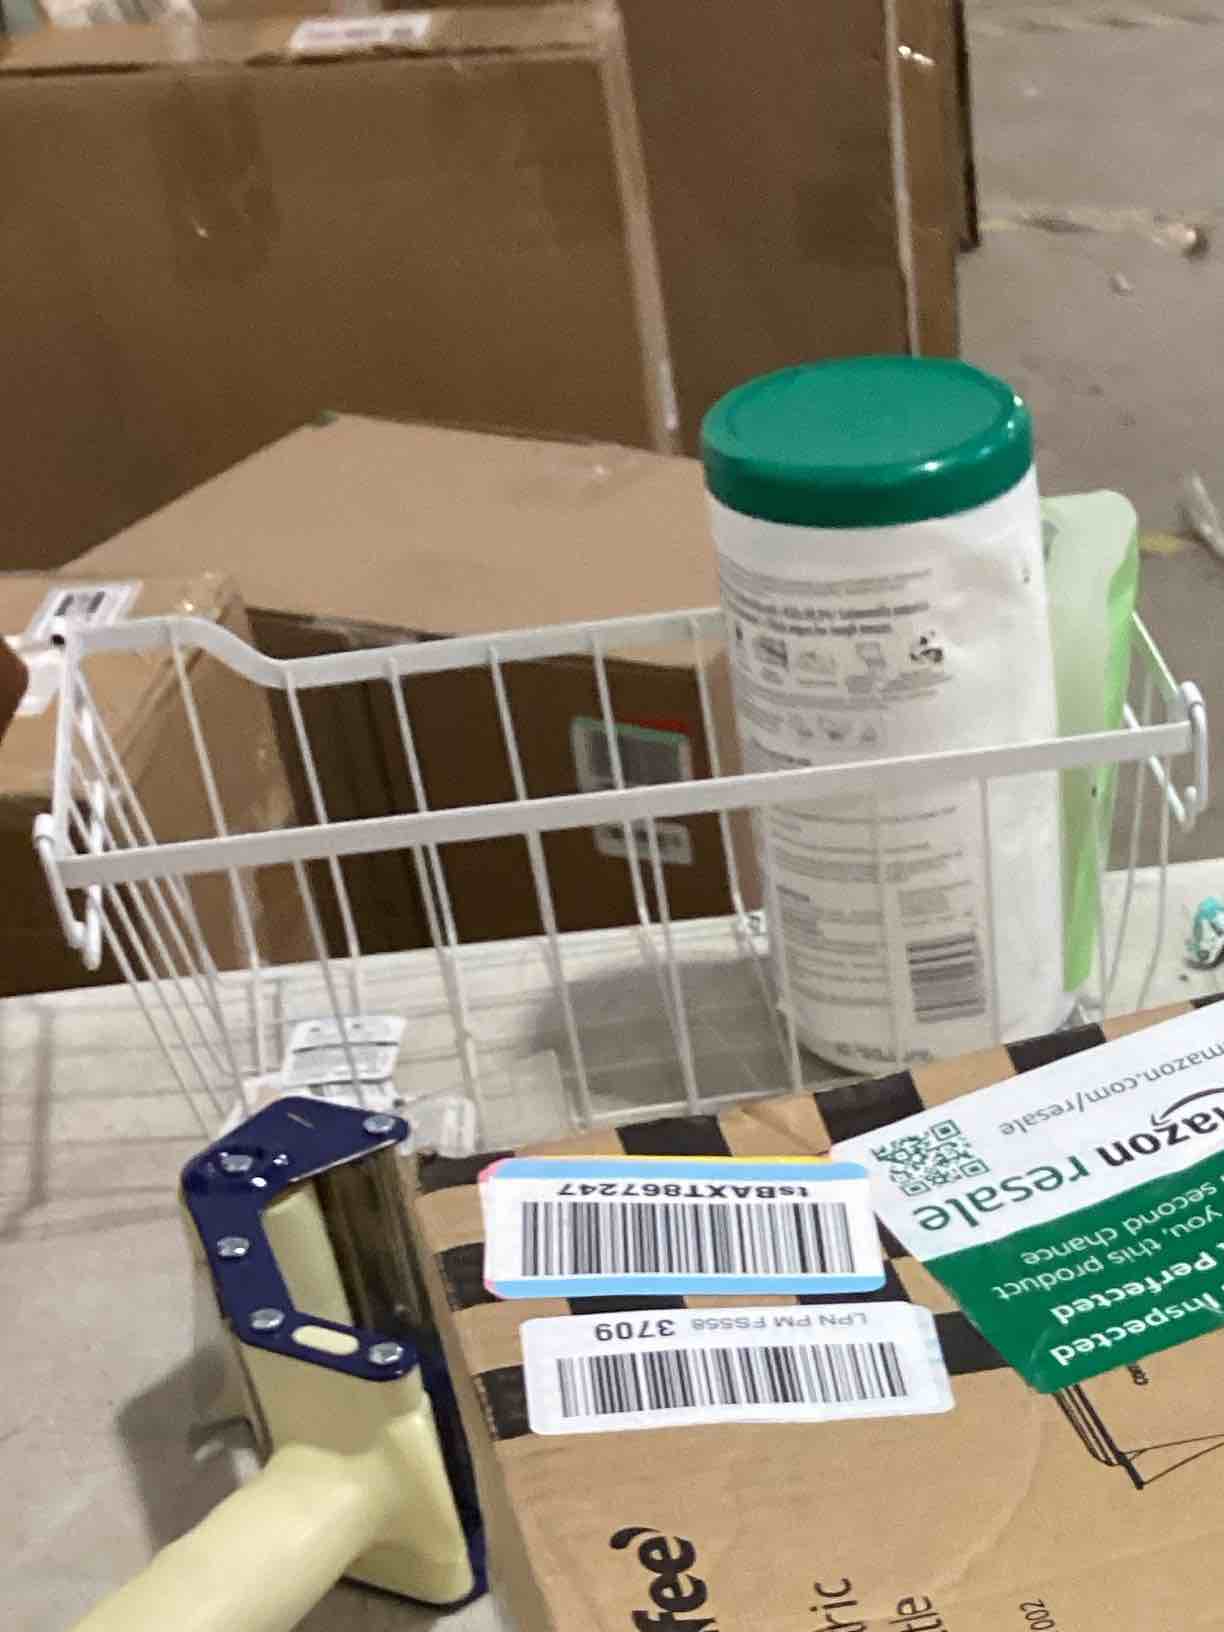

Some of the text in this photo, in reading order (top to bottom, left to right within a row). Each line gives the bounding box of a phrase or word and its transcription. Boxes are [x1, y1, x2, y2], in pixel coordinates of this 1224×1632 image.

[556, 1181, 809, 1200] tsBAXT867247
[912, 1155, 1090, 1231] resale
[1122, 1182, 1217, 1235] second
[1162, 1204, 1223, 1239] you,
[1020, 1227, 1119, 1265] chance
[1107, 1237, 1162, 1265] this
[991, 1254, 1105, 1301] product
[1049, 1251, 1218, 1326] Perfected
[593, 1318, 676, 1343] 3709
[772, 1314, 812, 1330] PM
[817, 1309, 867, 1328] LPN
[1049, 1292, 1221, 1367] Inspected
